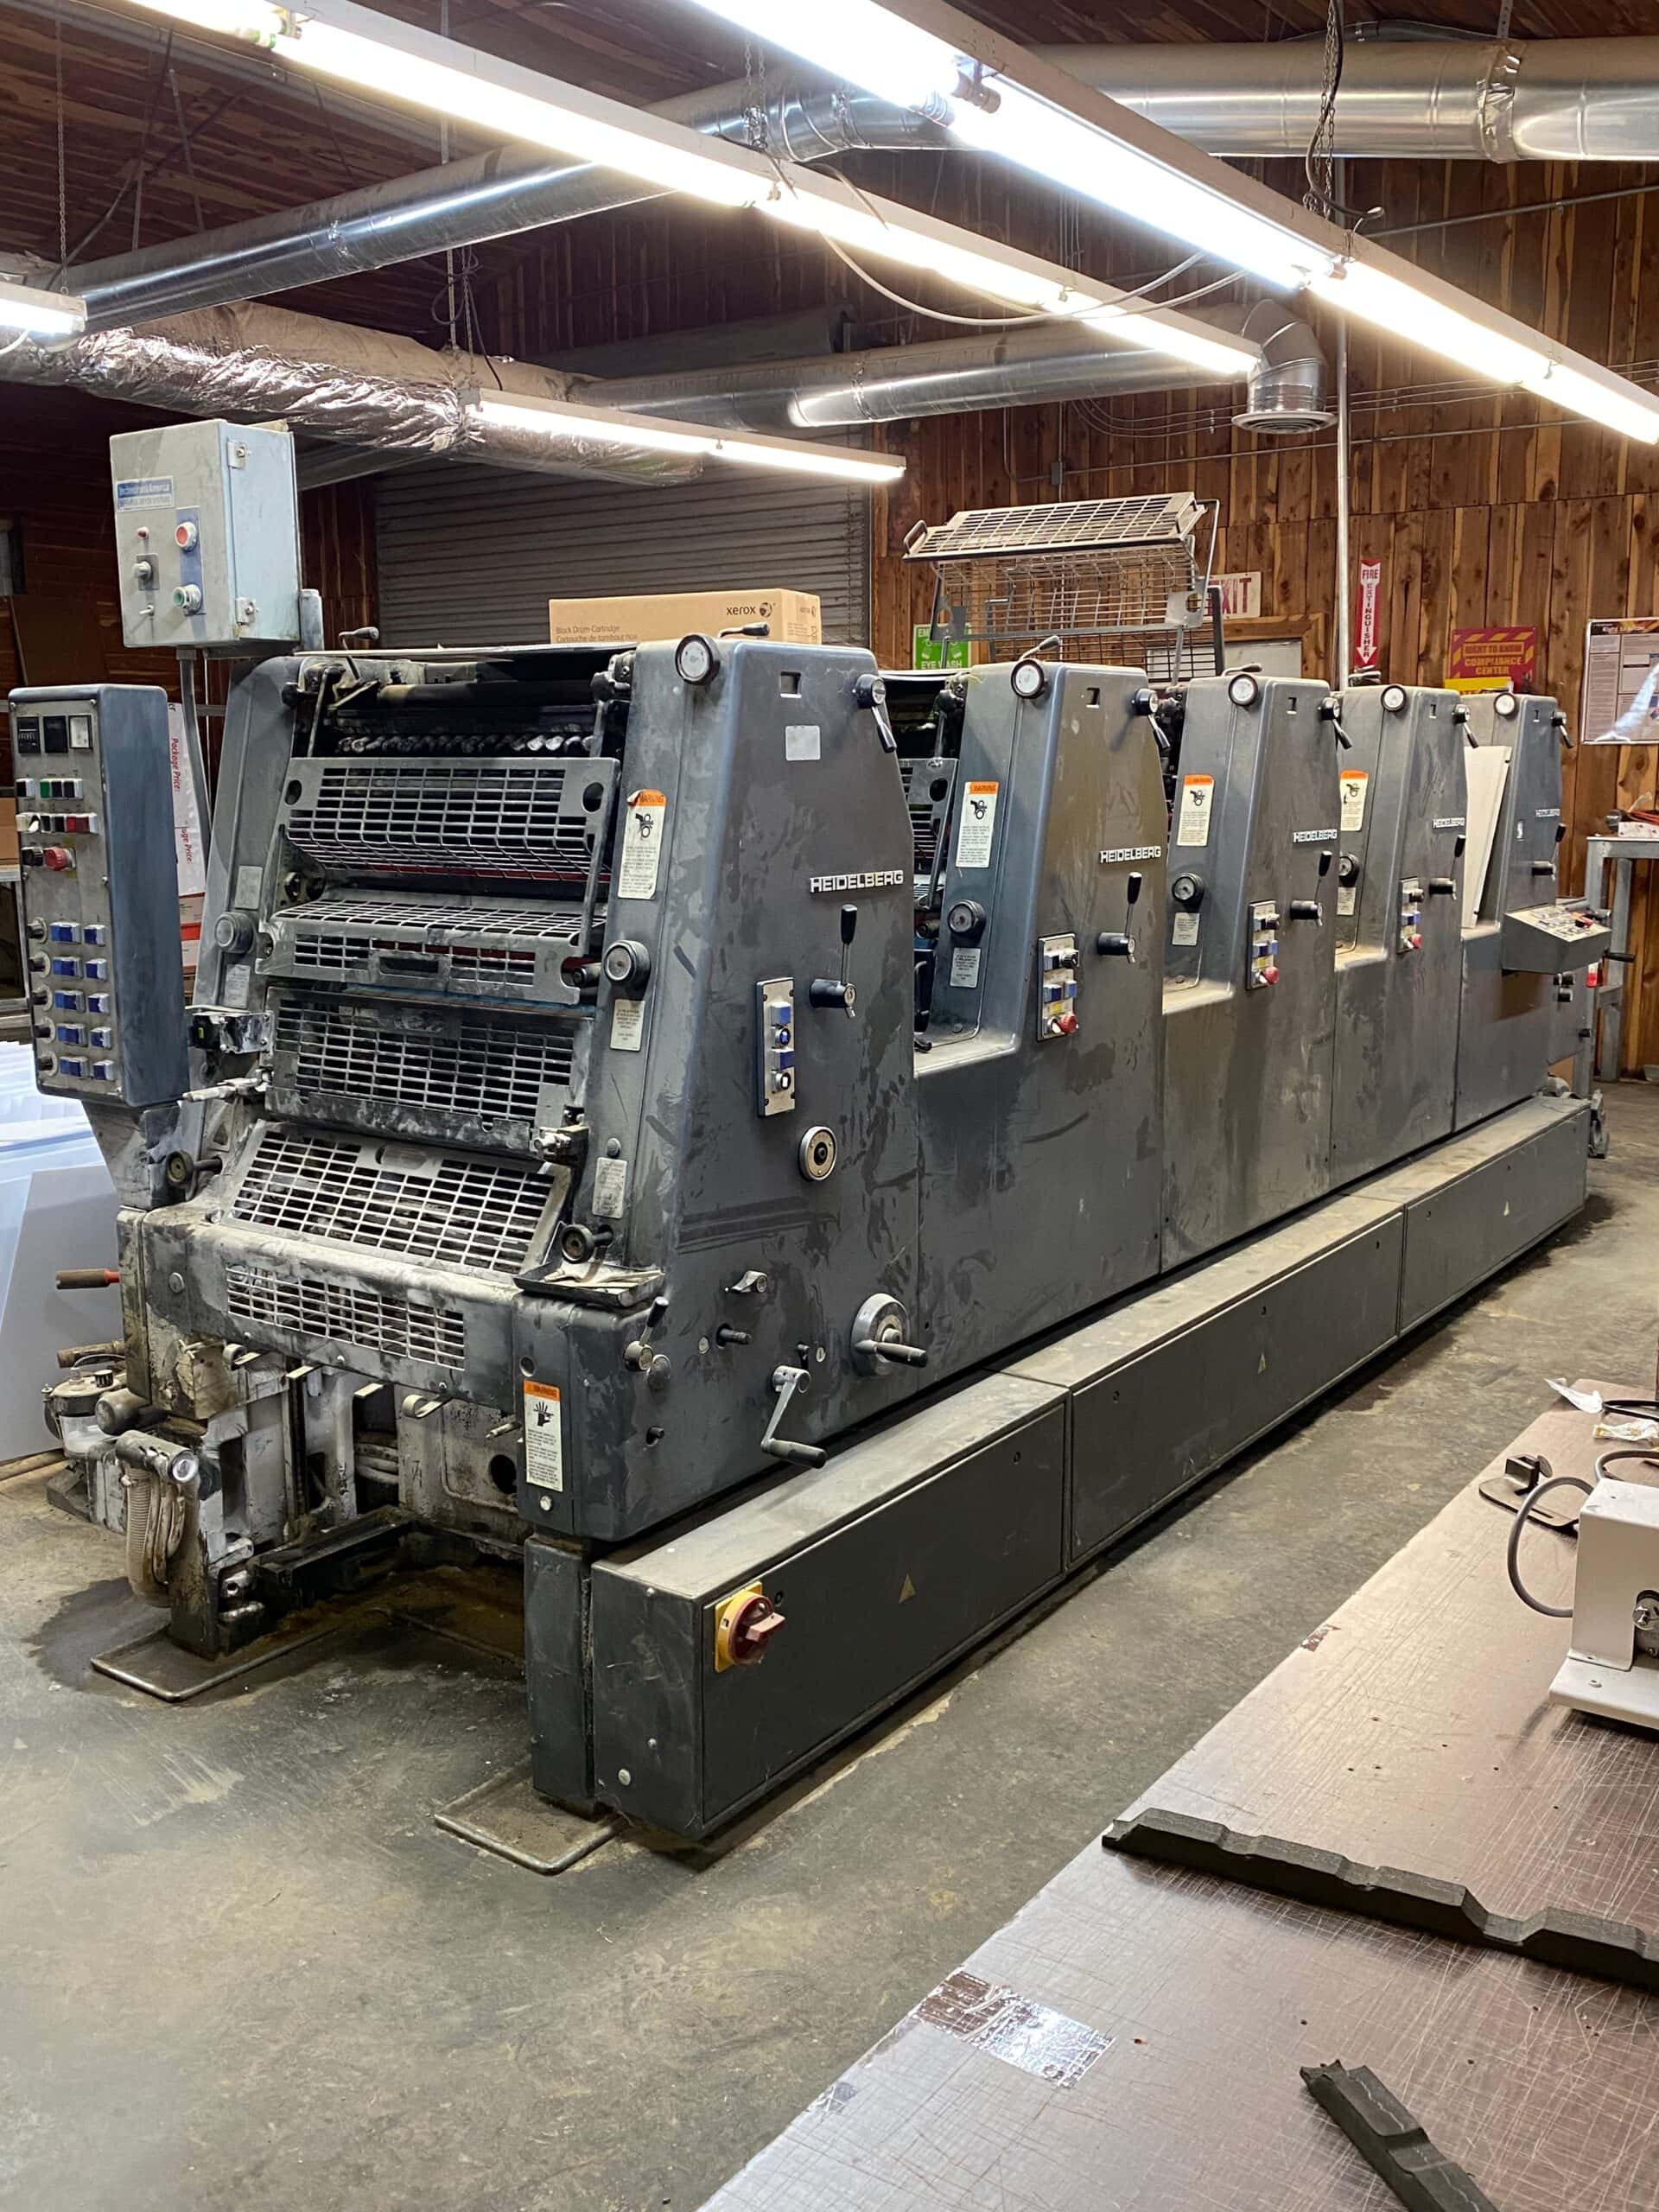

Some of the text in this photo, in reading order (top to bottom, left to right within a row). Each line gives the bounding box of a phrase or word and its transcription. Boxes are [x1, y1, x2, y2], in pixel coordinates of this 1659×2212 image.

[1363, 569, 1378, 579] FIRE
[726, 606, 756, 615] xerox
[1363, 583, 1372, 657] EXTINGUISHER
[921, 661, 937, 670] EYE
[1465, 656, 1522, 667] COMPLIANCE
[1476, 666, 1510, 676] CENTER
[1293, 829, 1338, 843] HEIDELBERG
[1099, 845, 1161, 864] HEIDELBERG
[810, 869, 904, 893] HEIDELBERG
